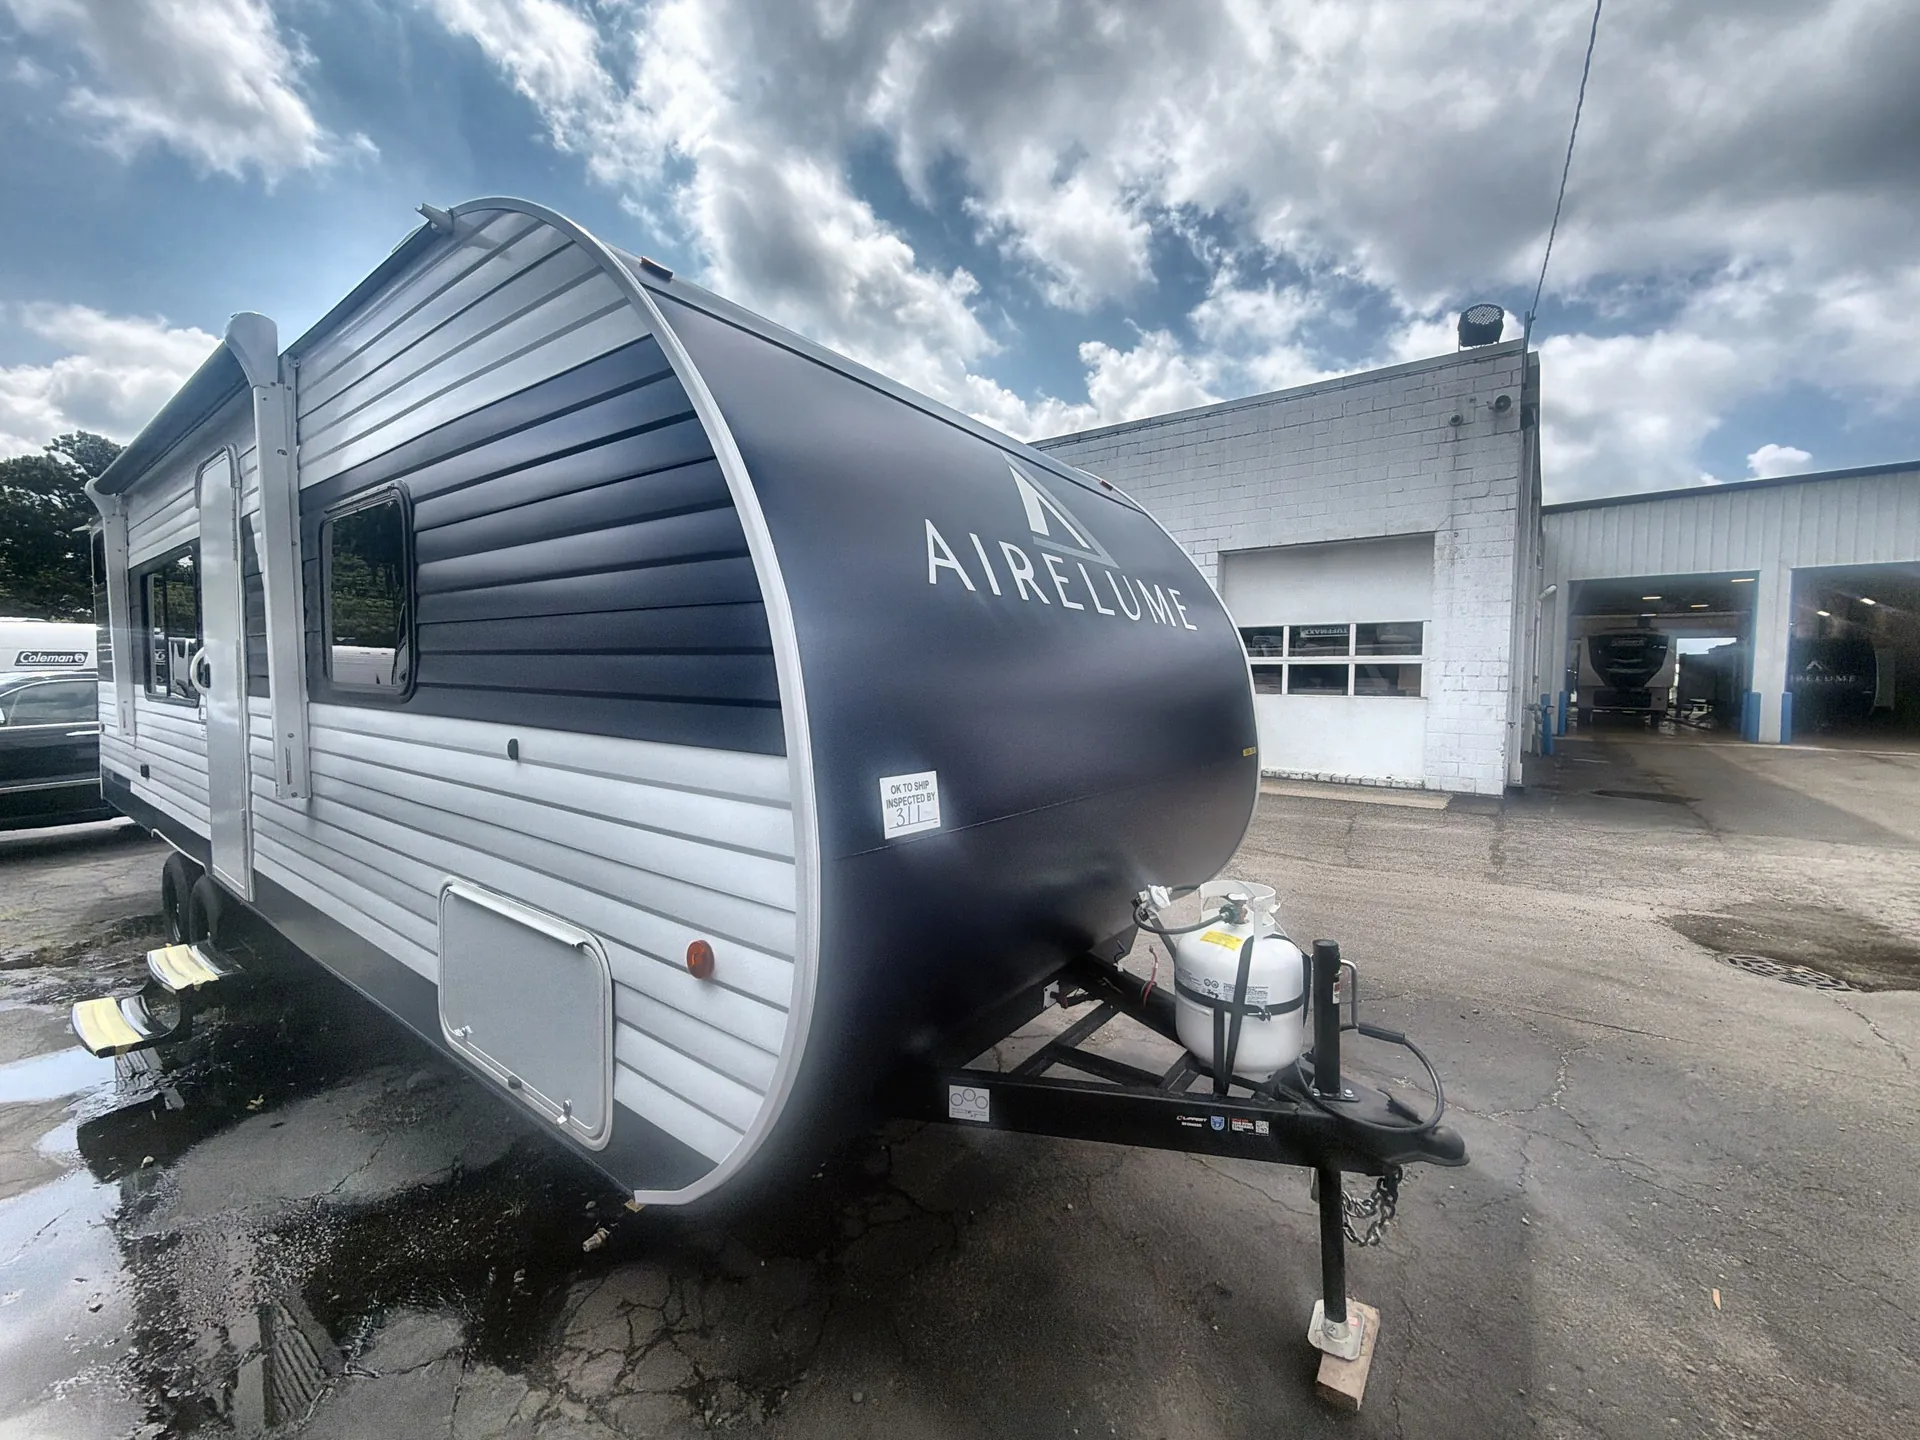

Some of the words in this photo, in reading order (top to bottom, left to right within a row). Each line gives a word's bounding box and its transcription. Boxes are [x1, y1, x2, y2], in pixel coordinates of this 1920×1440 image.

[925, 518, 1198, 631] AIRELUME
[20, 652, 73, 663] Coleman
[890, 784, 901, 795] OK
[903, 782, 913, 792] TO
[914, 780, 929, 791] SHIP
[886, 793, 925, 809] INSPECTED
[926, 791, 936, 802] BY
[896, 805, 920, 827] 311
